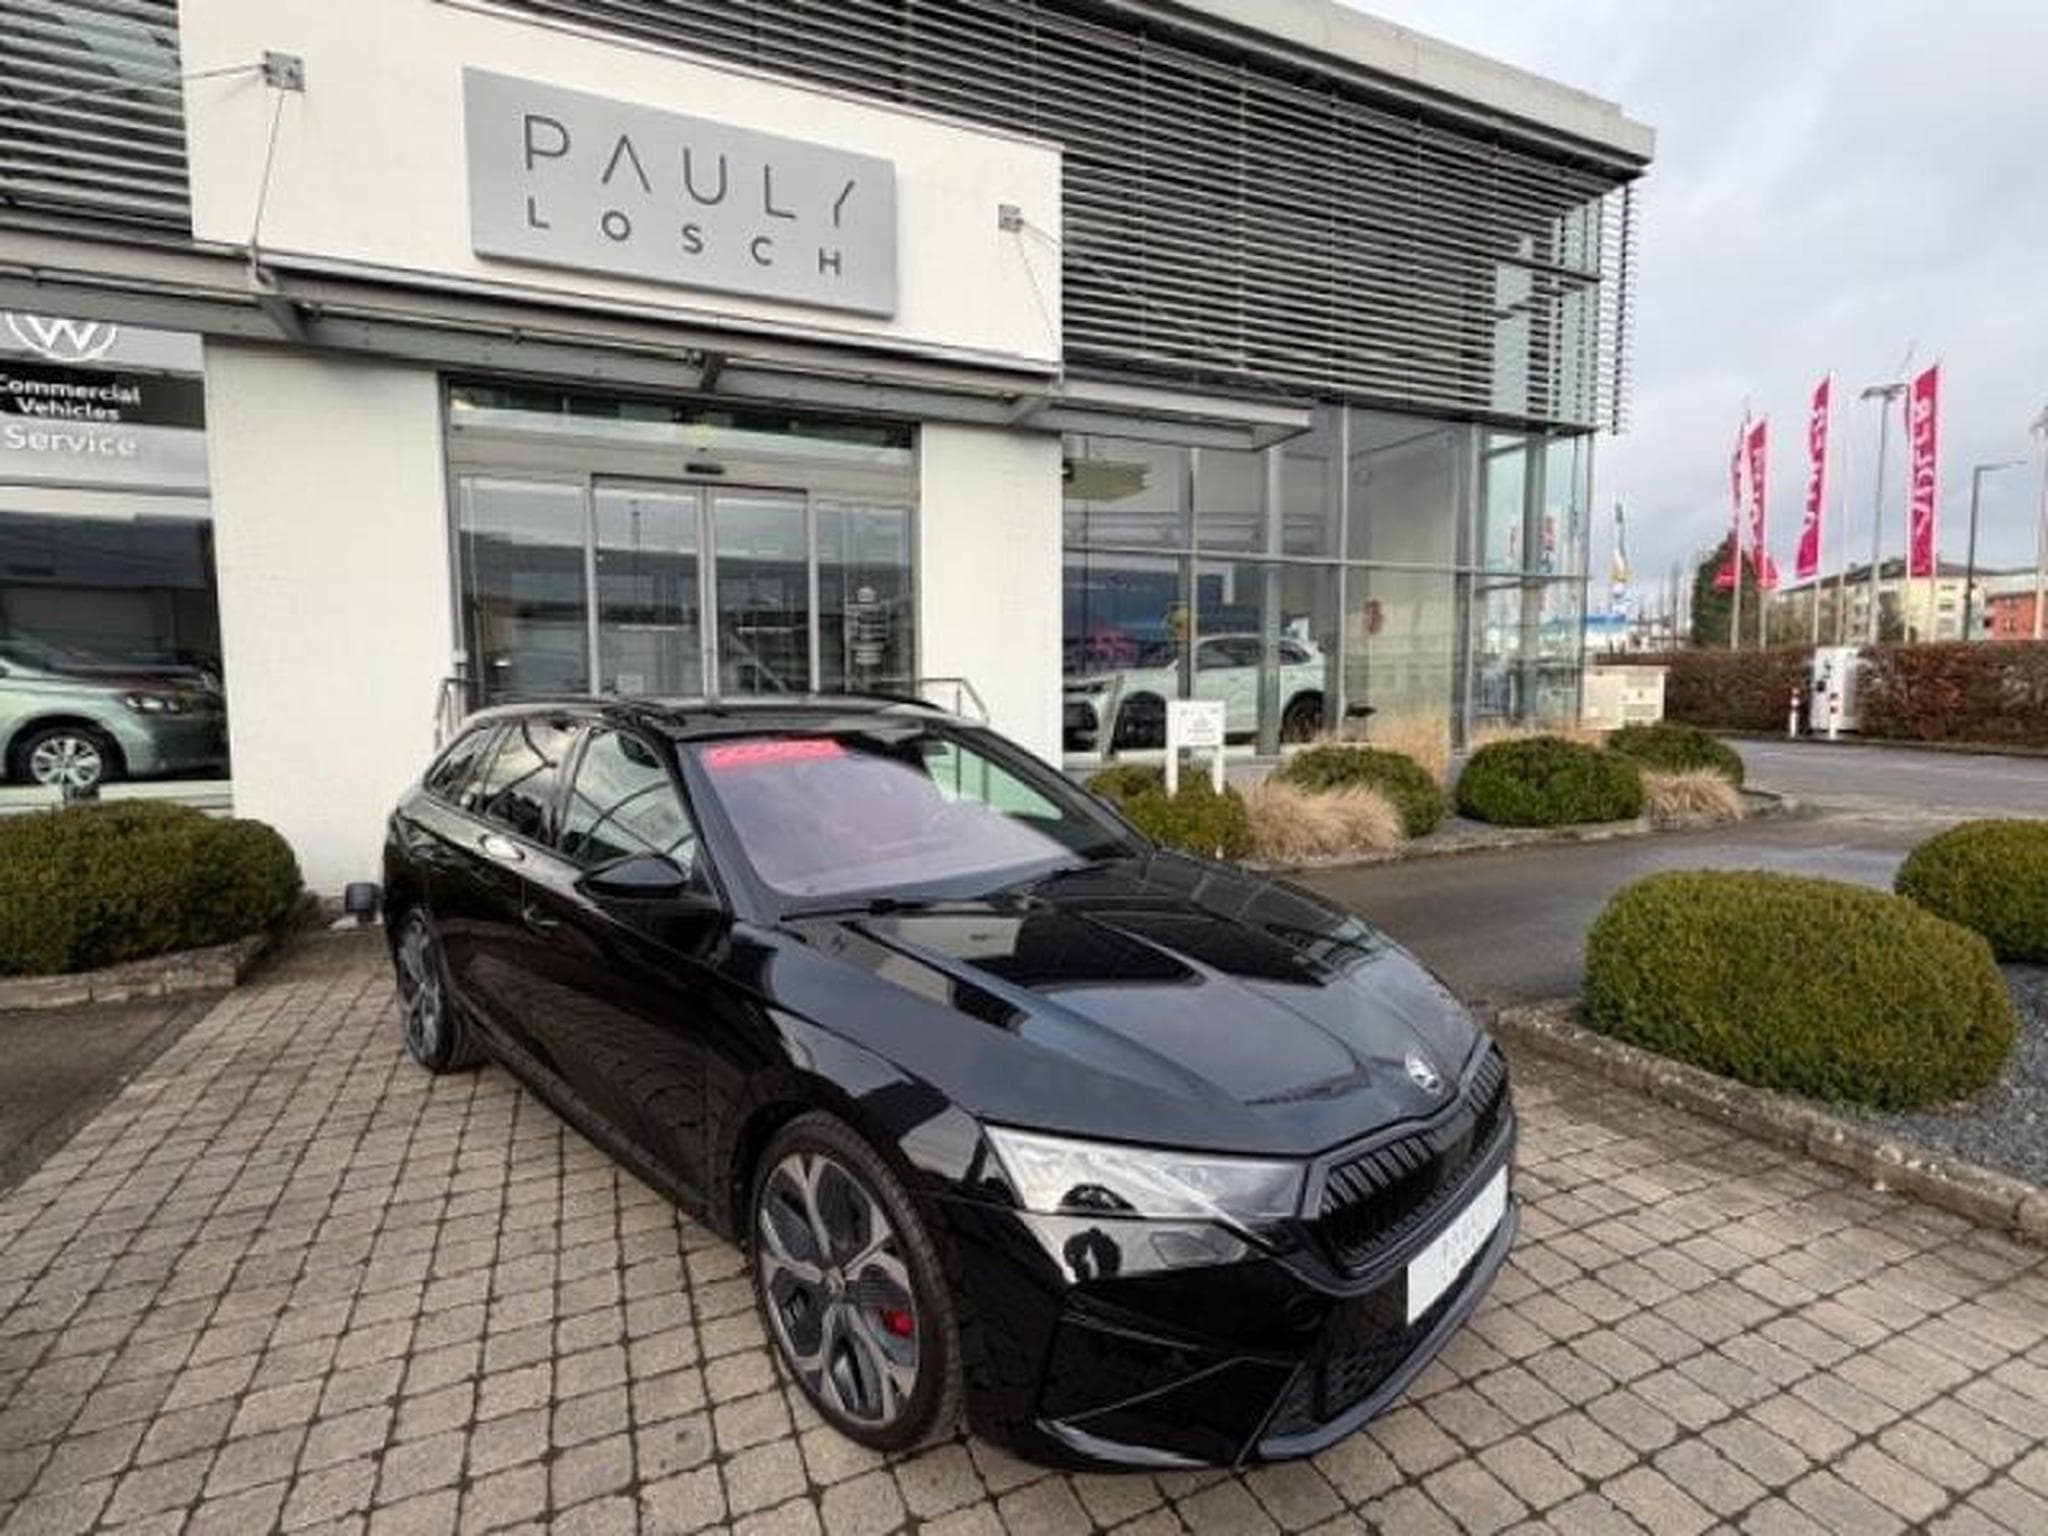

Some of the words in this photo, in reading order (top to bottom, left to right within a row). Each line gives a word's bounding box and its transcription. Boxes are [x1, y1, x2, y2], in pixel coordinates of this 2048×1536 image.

[523, 113, 856, 228] PAULY
[527, 196, 842, 276] LOSCH
[15, 397, 120, 421] Vehicles
[4, 424, 138, 456] Service
